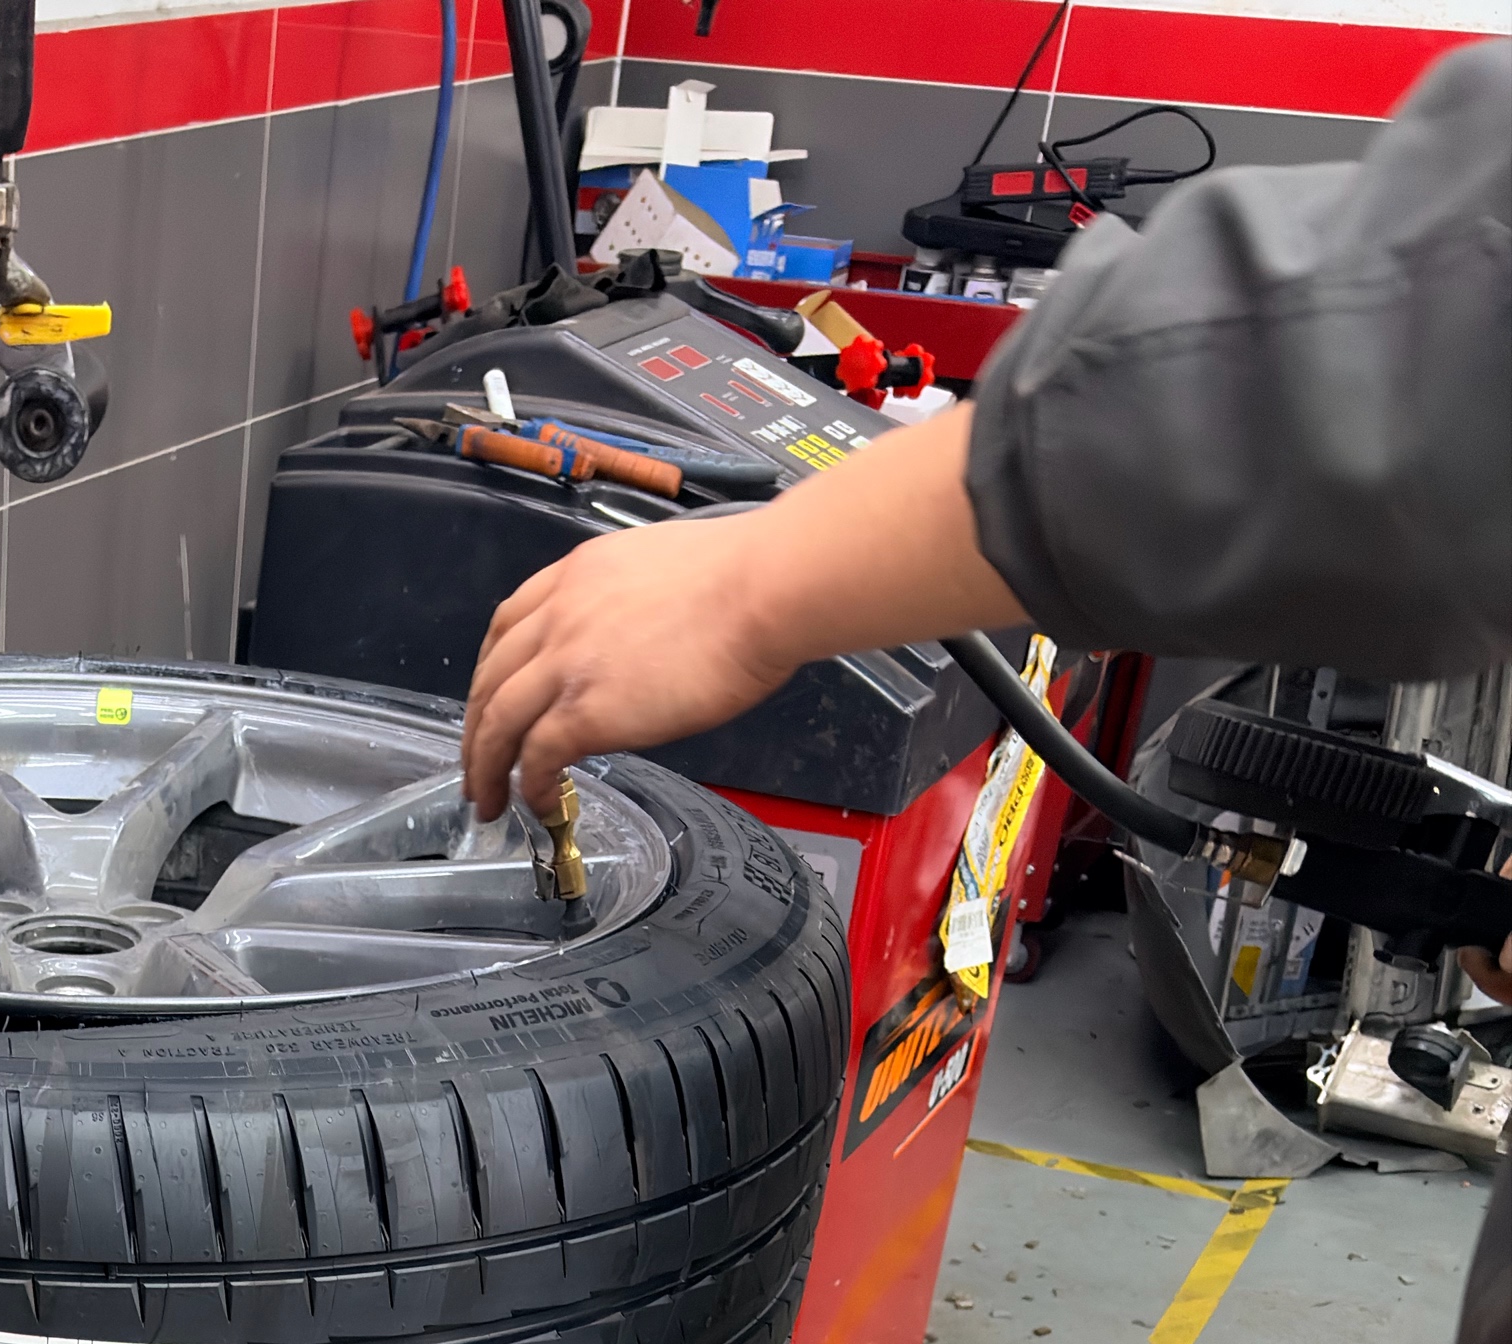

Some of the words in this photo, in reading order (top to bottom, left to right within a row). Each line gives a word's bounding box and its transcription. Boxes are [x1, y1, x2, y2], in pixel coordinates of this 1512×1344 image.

[542, 982, 582, 1004] Total
[430, 991, 539, 1018] Performance
[490, 996, 594, 1032] MICHELIN
[230, 1022, 362, 1042] TEMPERATURE
[310, 1030, 418, 1052] TREADWEAR
[143, 1048, 236, 1059] TRACTION
